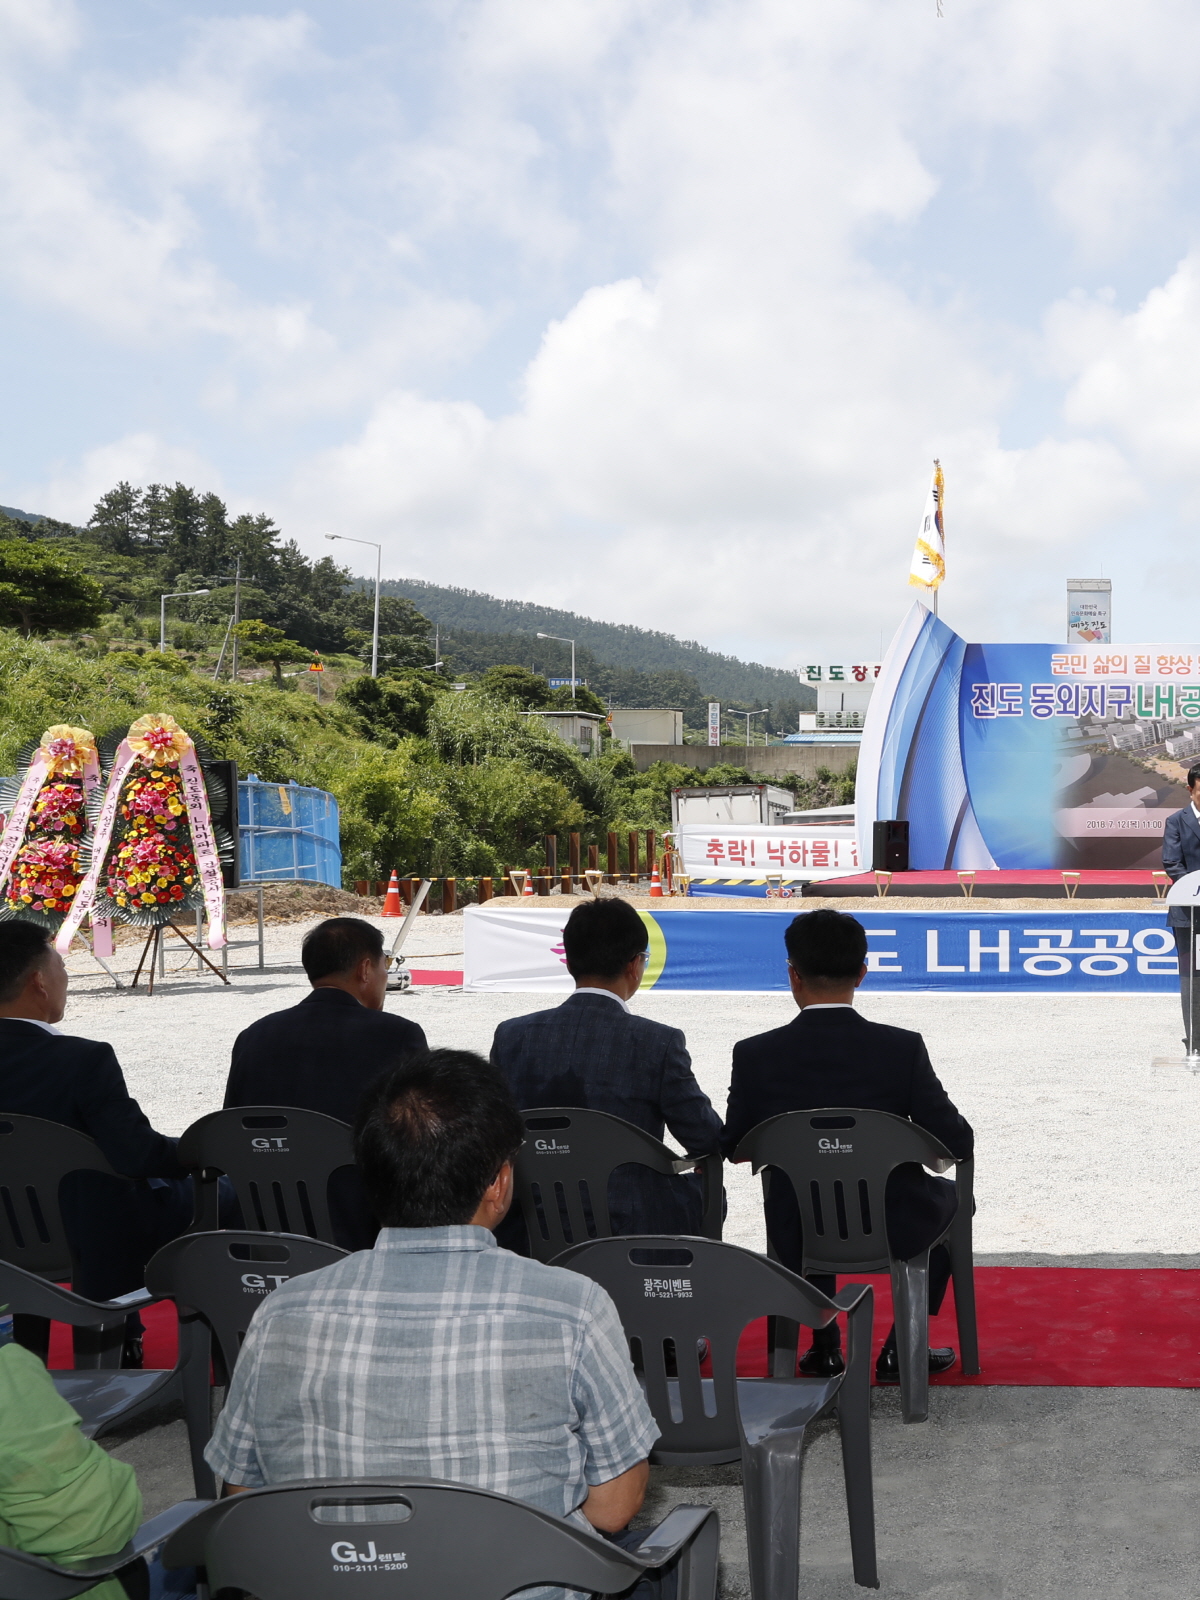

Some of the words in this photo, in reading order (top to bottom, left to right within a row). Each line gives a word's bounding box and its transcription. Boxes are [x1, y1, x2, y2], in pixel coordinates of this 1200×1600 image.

[1052, 655, 1087, 674] 군민
[1093, 655, 1128, 674] 삶의
[1134, 655, 1151, 674] 질
[1157, 655, 1192, 674] 향상
[972, 684, 1022, 718] 진도
[1143, 820, 1162, 829] 11:00
[706, 838, 755, 866] 추락!
[767, 840, 838, 867] 낙하물!
[251, 1137, 287, 1148] GT
[241, 1273, 289, 1289] GT
[643, 1278, 693, 1292] 광주이벤트
[333, 1562, 408, 1572] 010-2111-5200
